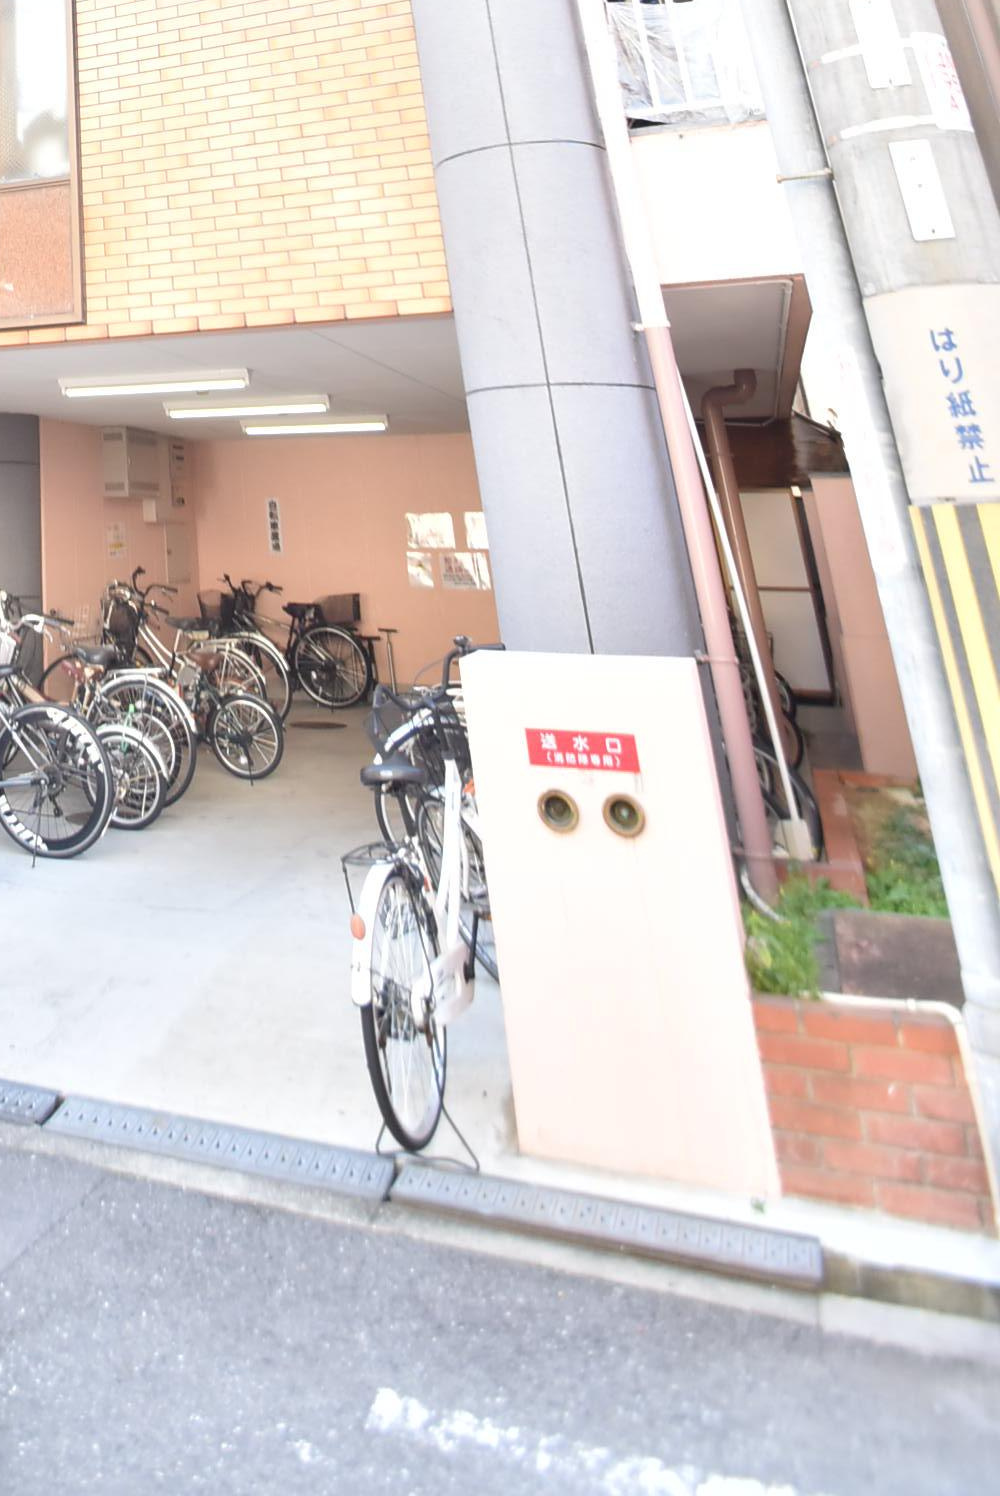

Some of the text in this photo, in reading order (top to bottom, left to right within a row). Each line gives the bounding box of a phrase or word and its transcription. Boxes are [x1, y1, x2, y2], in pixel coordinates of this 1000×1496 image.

[929, 327, 995, 483] はり紙禁止
[540, 733, 622, 753] 送水口
